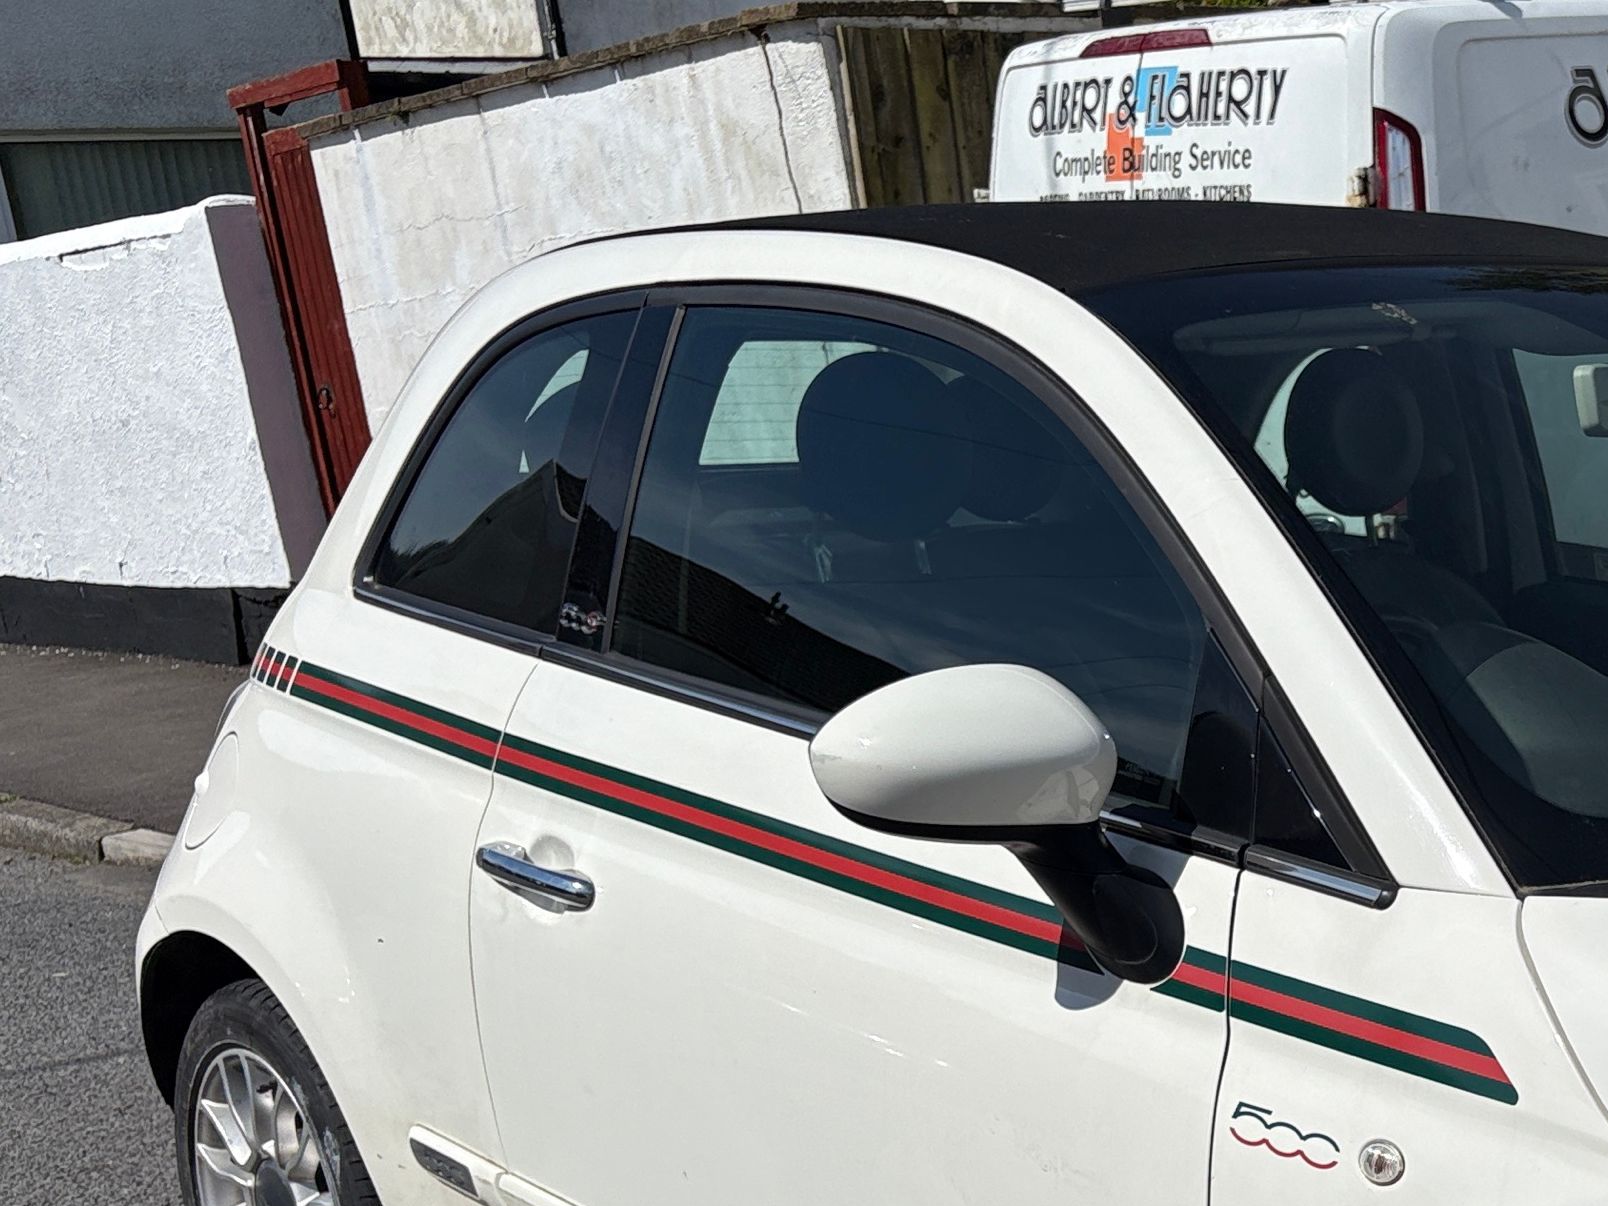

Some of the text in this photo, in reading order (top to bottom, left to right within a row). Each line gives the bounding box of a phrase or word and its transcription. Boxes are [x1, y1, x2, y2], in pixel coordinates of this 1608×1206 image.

[1115, 73, 1138, 128] &
[1053, 141, 1252, 184] Complete Building Service
[1202, 184, 1252, 203] KITCHENS
[1229, 1101, 1340, 1170] 500
